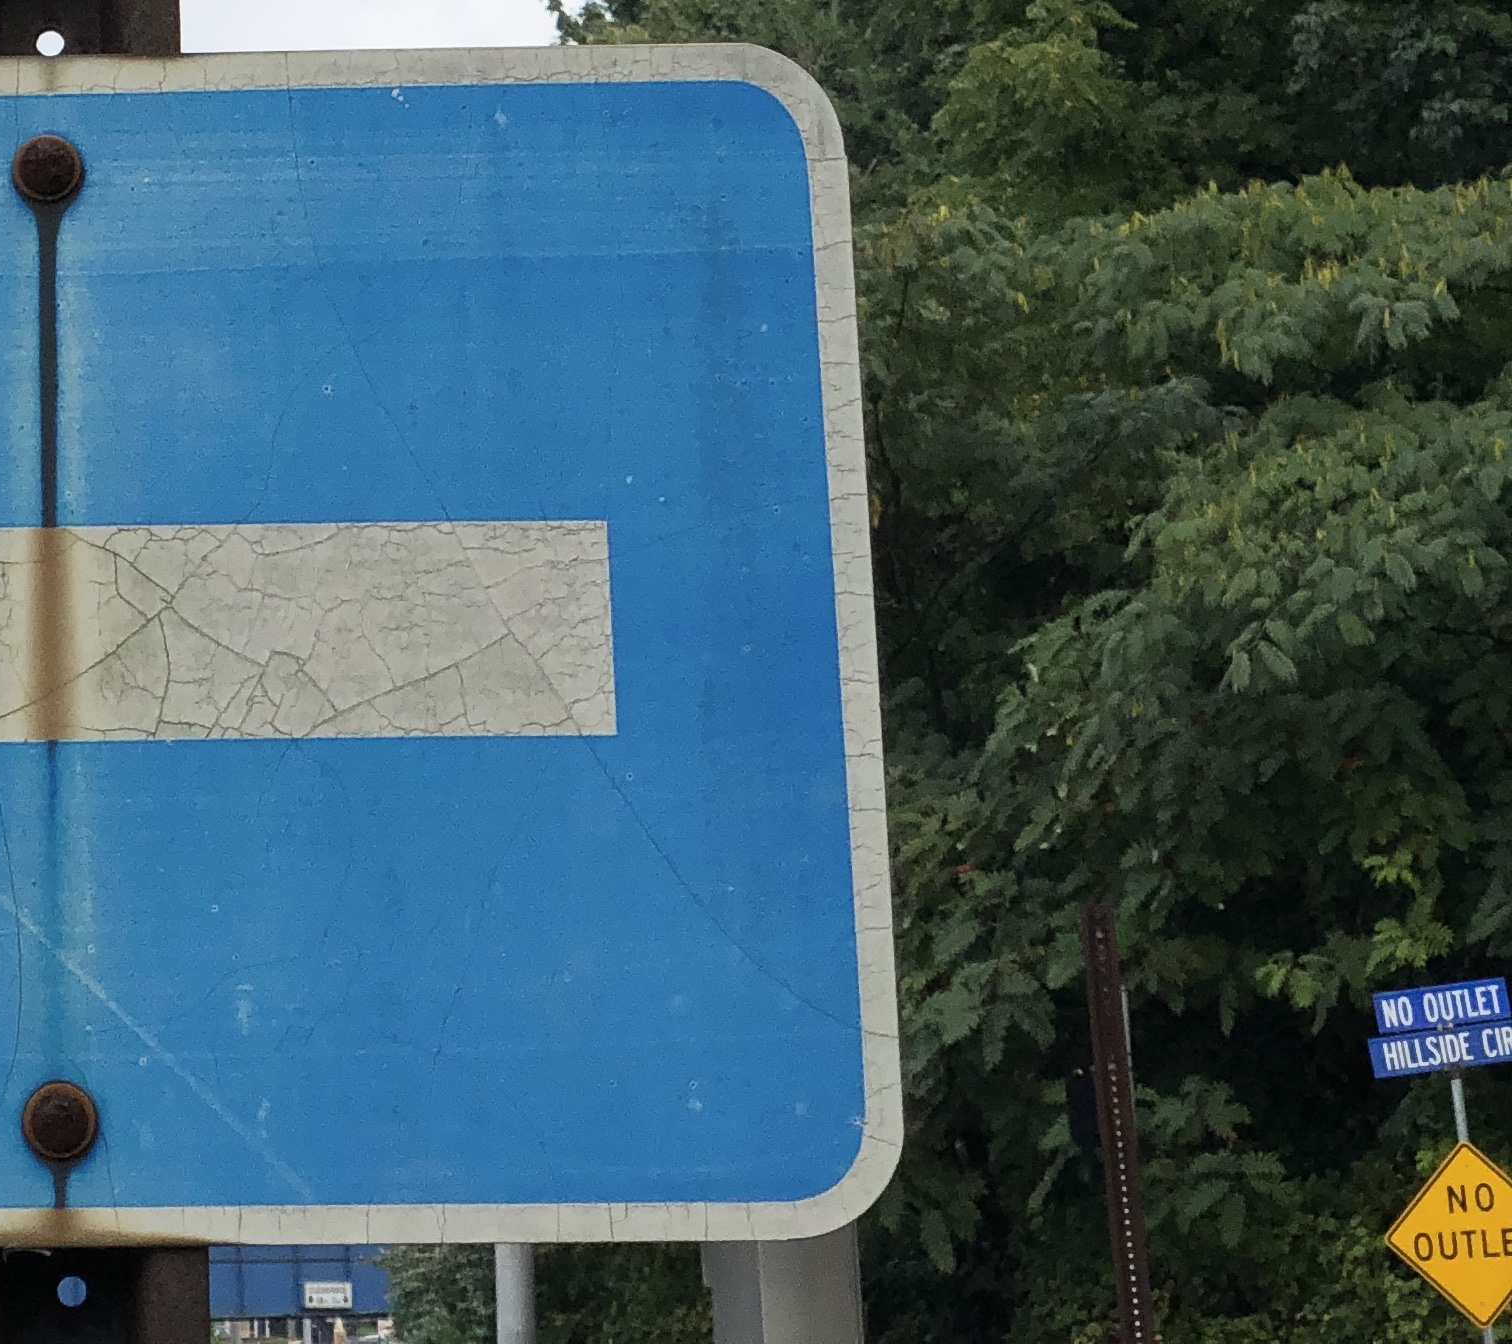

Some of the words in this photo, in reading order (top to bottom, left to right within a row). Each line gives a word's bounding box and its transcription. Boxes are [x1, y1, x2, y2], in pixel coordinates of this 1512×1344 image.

[1381, 996, 1414, 1028] NO
[1422, 984, 1501, 1023] OUTLET
[1382, 1032, 1475, 1071] HILLSIDE
[1446, 1182, 1495, 1214] NO
